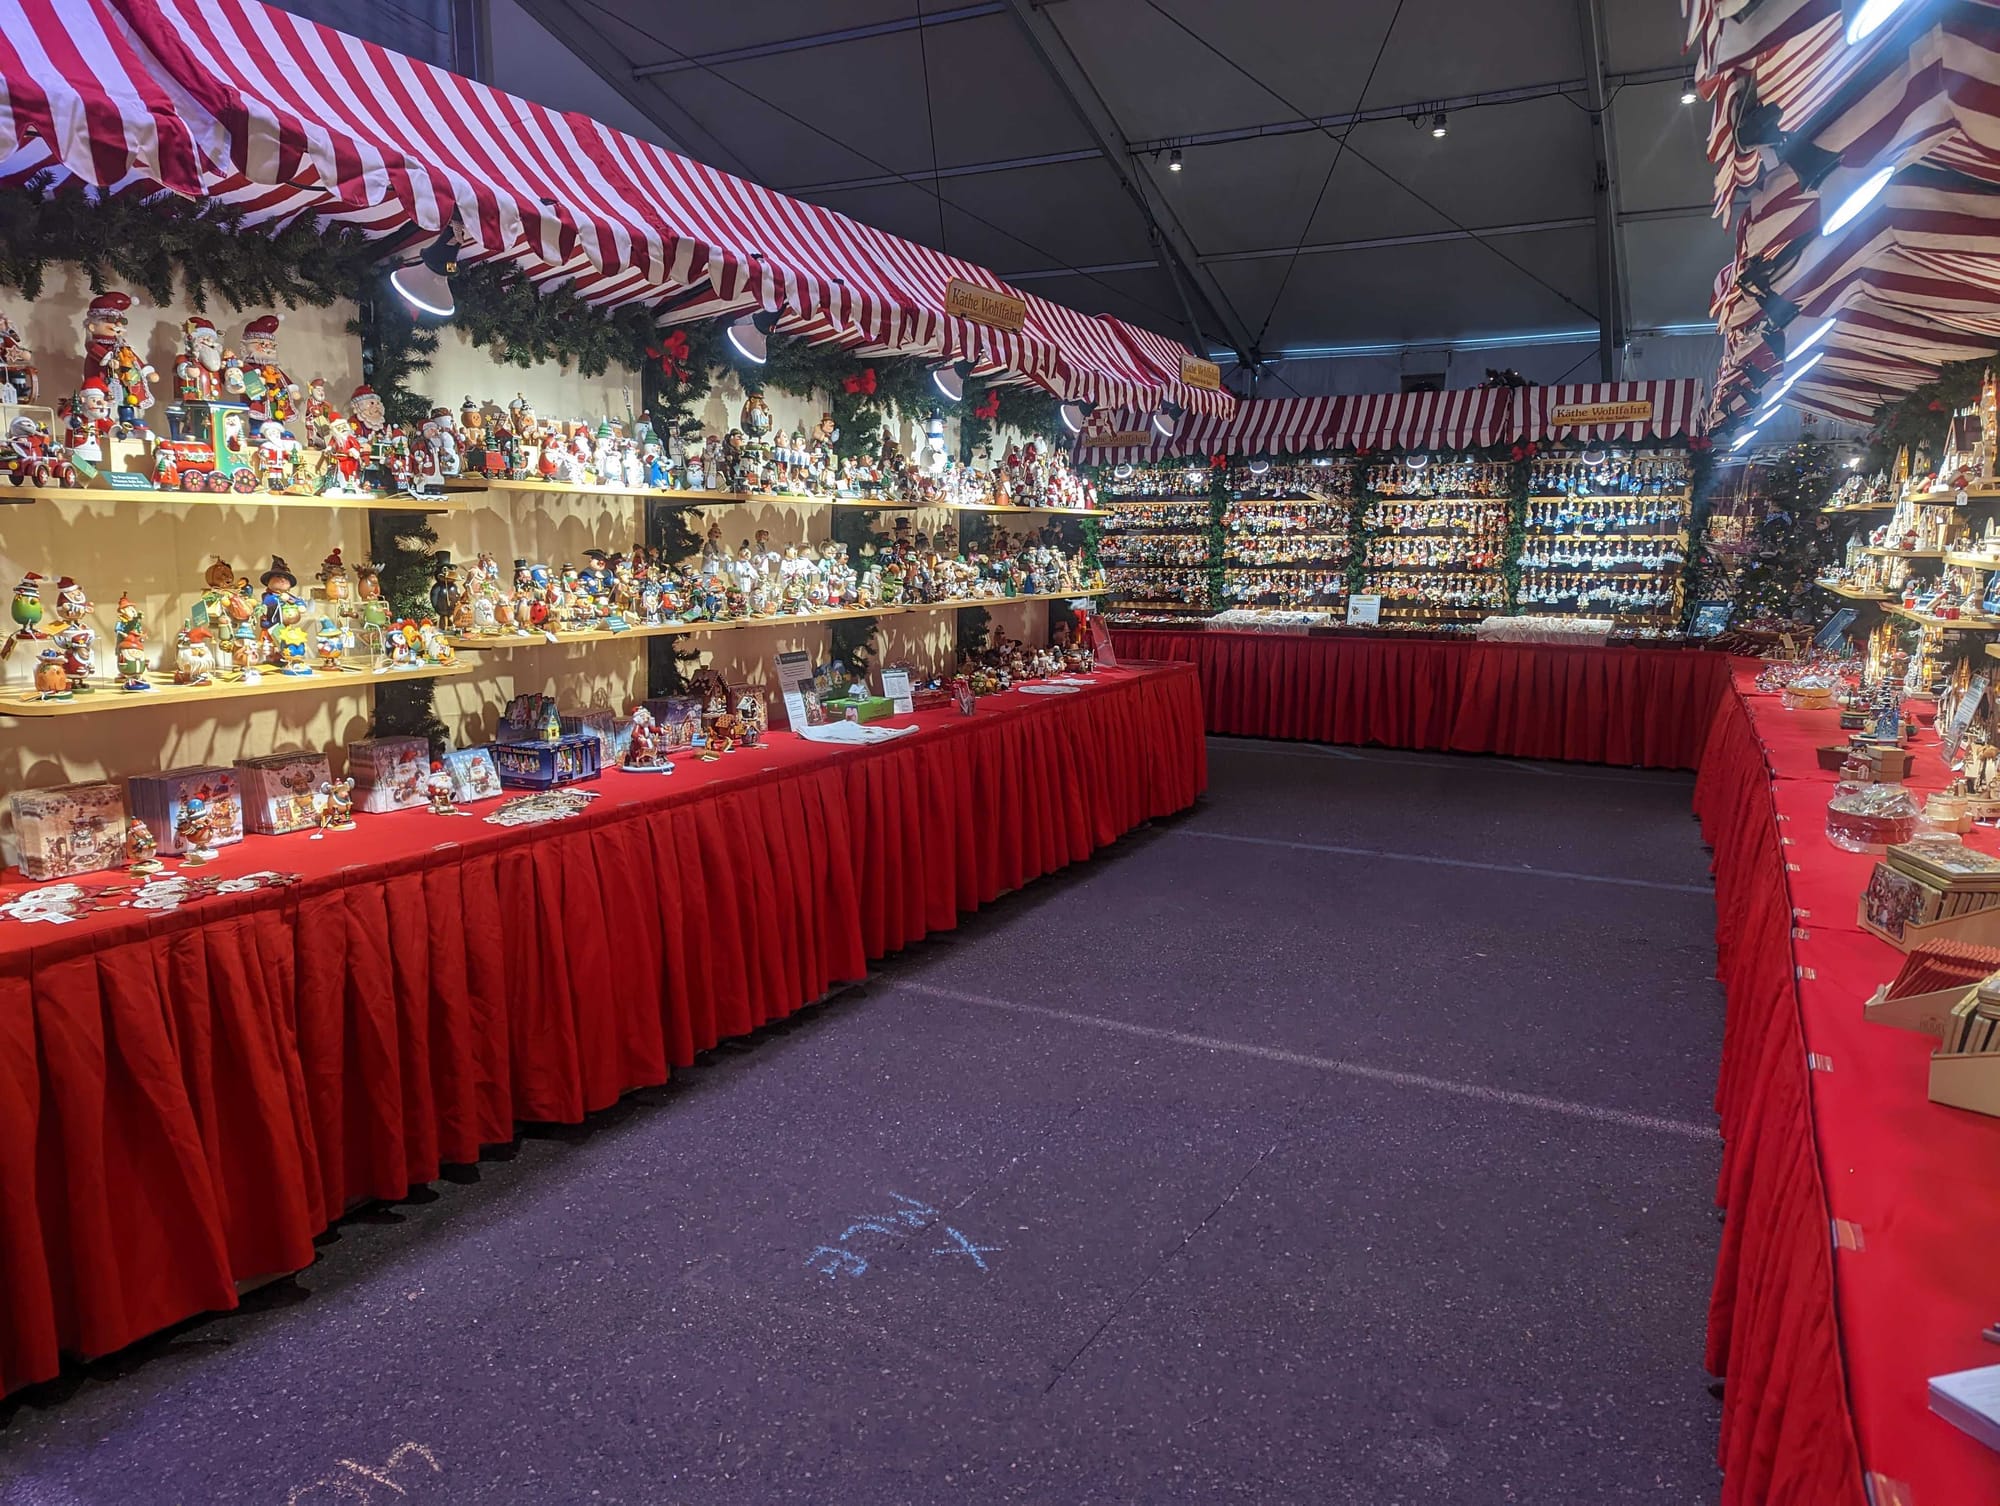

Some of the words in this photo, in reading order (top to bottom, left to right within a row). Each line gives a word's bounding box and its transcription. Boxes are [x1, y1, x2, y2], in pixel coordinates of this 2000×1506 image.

[952, 287, 978, 311] Käthe
[981, 296, 1022, 323] Wohlfahrt
[1557, 408, 1588, 418] Käthe
[1592, 405, 1647, 416] Wohlfahrt
